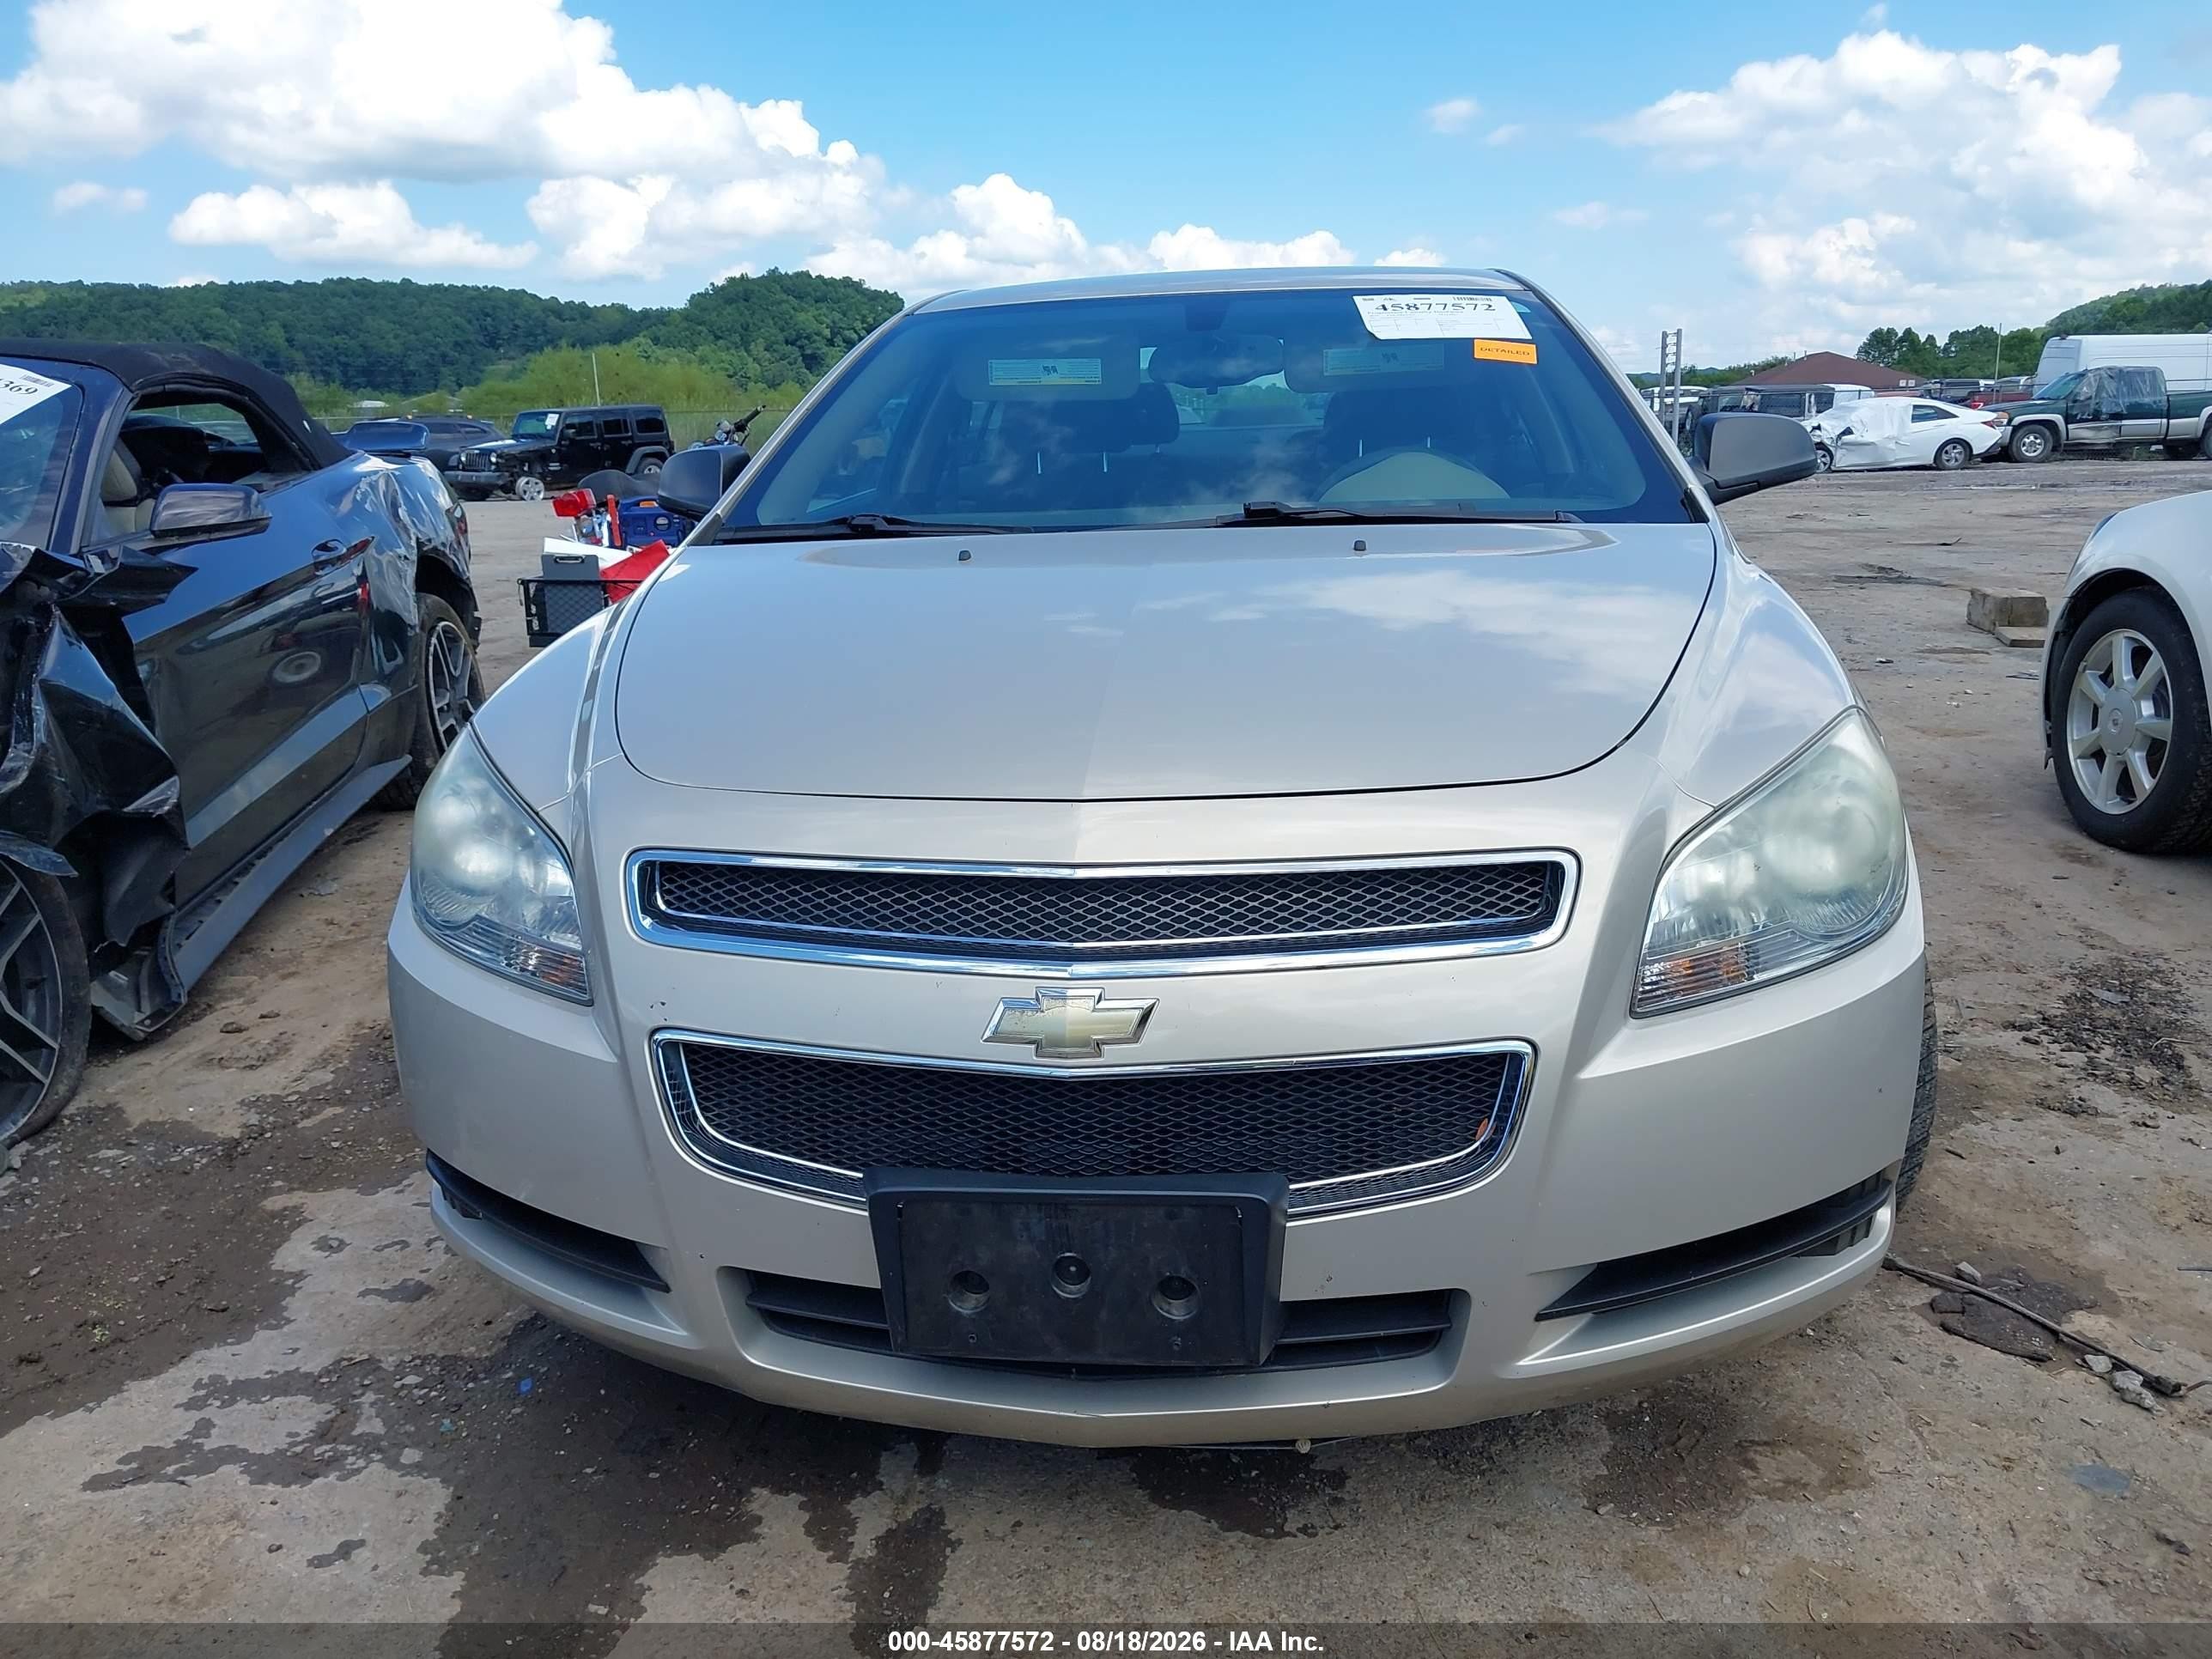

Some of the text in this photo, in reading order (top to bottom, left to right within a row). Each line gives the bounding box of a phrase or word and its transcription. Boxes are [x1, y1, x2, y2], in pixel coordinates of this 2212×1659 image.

[1375, 303, 1496, 312] 45877572
[1480, 347, 1530, 356] DETAILED
[0, 379, 38, 394] 369
